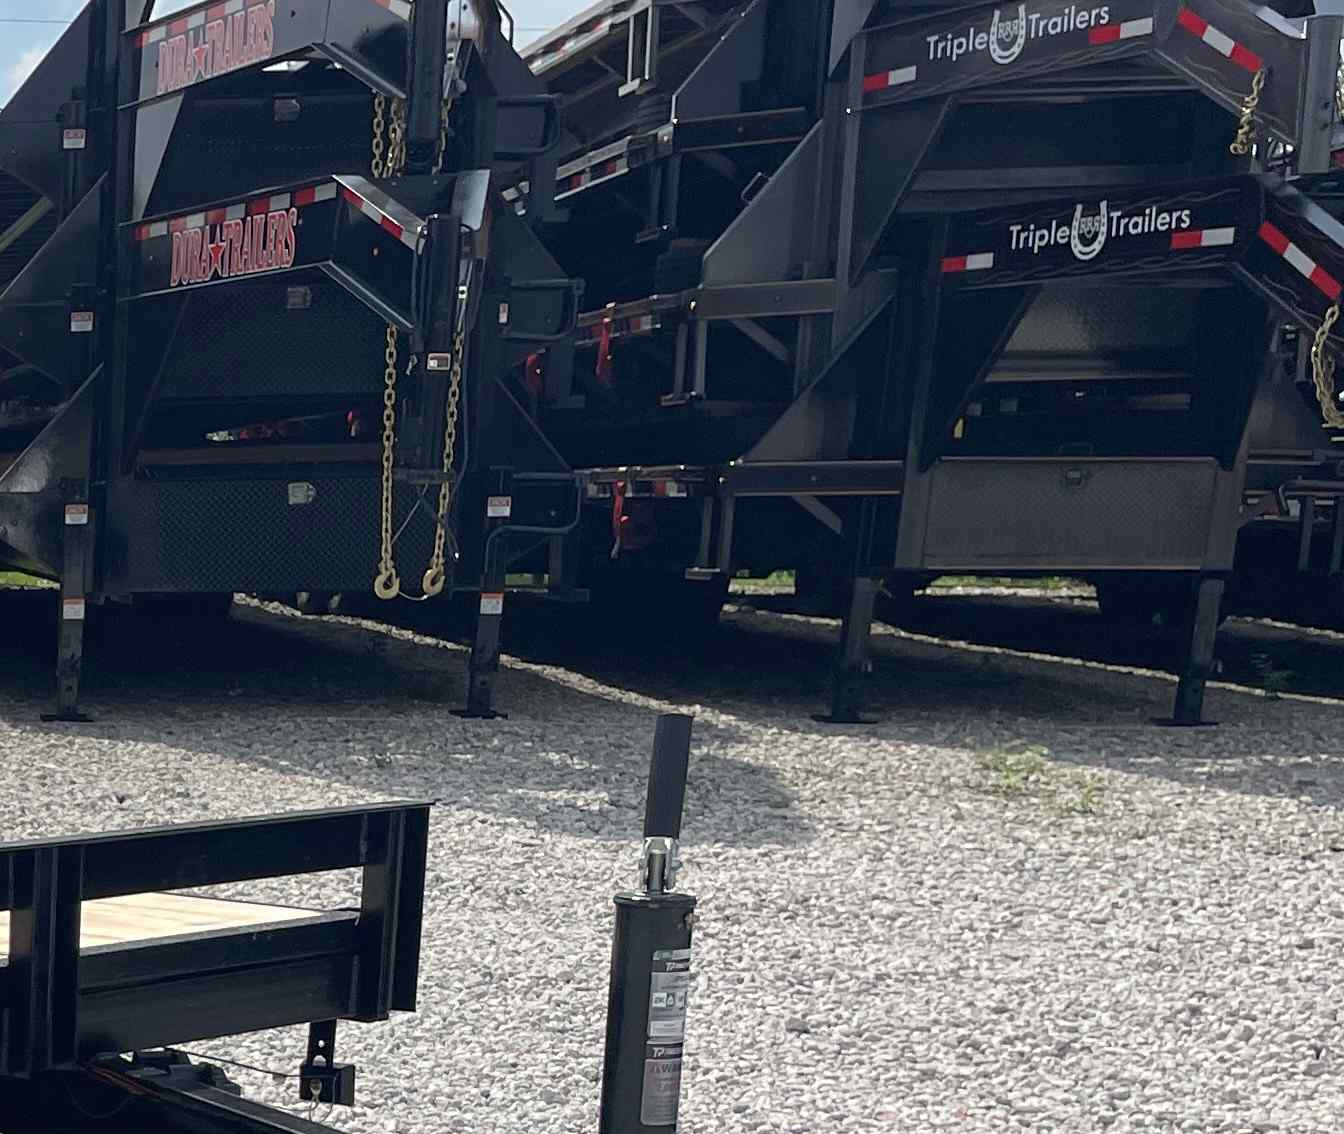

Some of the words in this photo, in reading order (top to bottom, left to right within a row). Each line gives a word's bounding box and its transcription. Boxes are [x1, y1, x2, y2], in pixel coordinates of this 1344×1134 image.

[926, 27, 987, 61] Triple
[1028, 5, 1110, 38] Trailers
[170, 225, 212, 287] DURA
[223, 207, 298, 277] TRAILERS
[1009, 220, 1070, 254] Triple
[1110, 206, 1191, 238] Trailers
